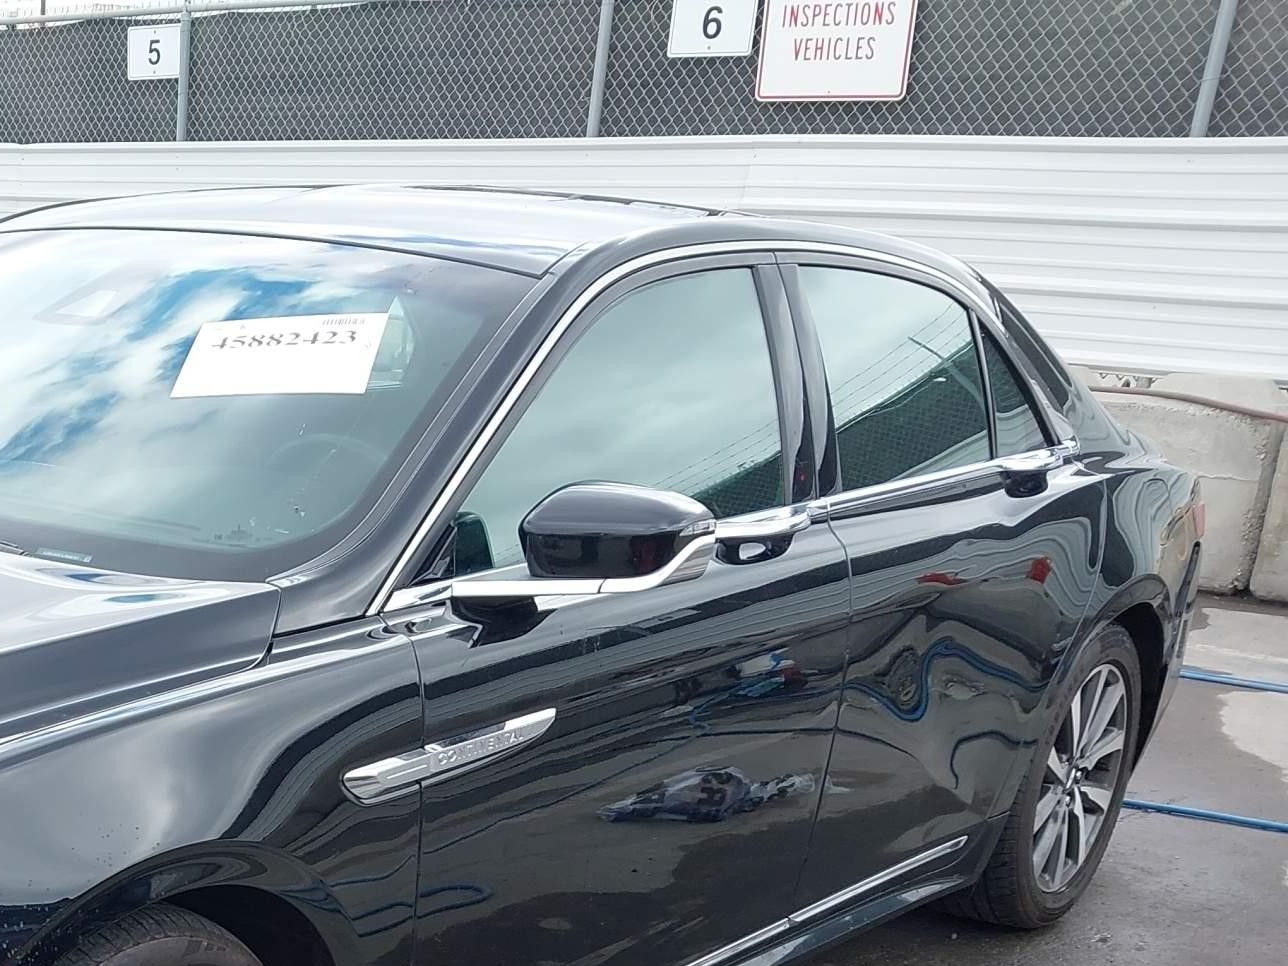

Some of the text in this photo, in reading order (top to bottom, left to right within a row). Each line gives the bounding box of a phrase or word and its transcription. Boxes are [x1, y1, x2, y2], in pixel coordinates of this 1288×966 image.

[701, 5, 724, 40] 6
[782, 1, 897, 28] INSPECTIONS
[148, 39, 161, 66] 5
[793, 36, 877, 61] VEHICLES
[211, 329, 358, 350] 45882423
